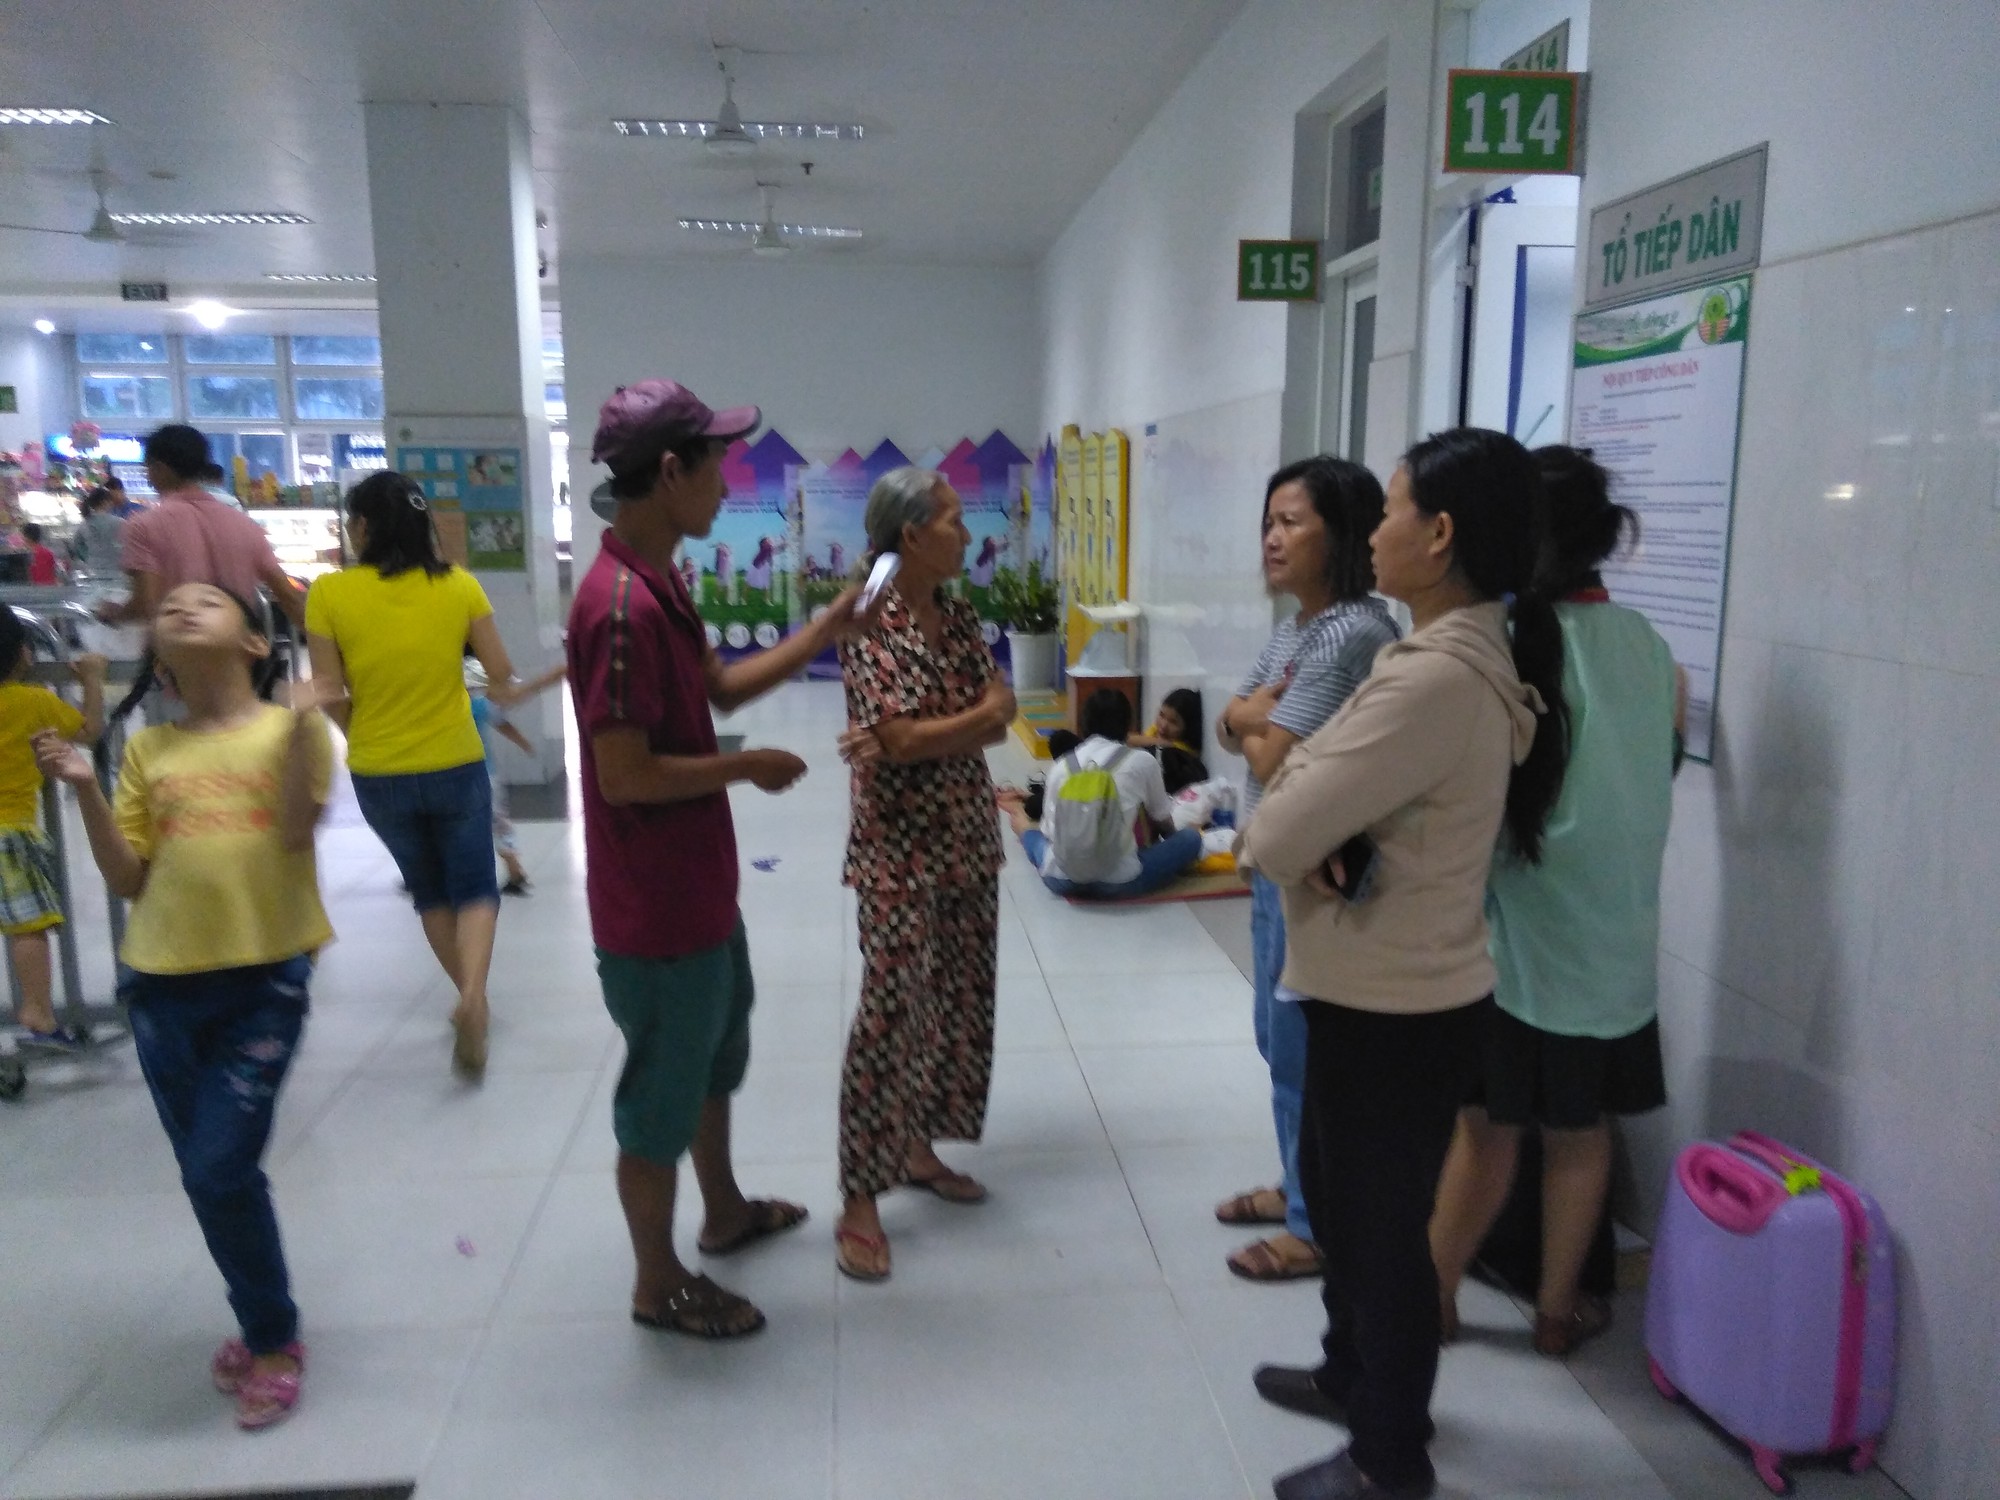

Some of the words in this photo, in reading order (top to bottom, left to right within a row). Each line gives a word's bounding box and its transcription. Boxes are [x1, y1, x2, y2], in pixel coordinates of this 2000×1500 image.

[1463, 91, 1562, 155] 114
[1248, 252, 1310, 291] 115
[1603, 211, 1631, 287] TỔ
[1634, 203, 1682, 278] TIẾP
[1686, 195, 1741, 264] DÂN
